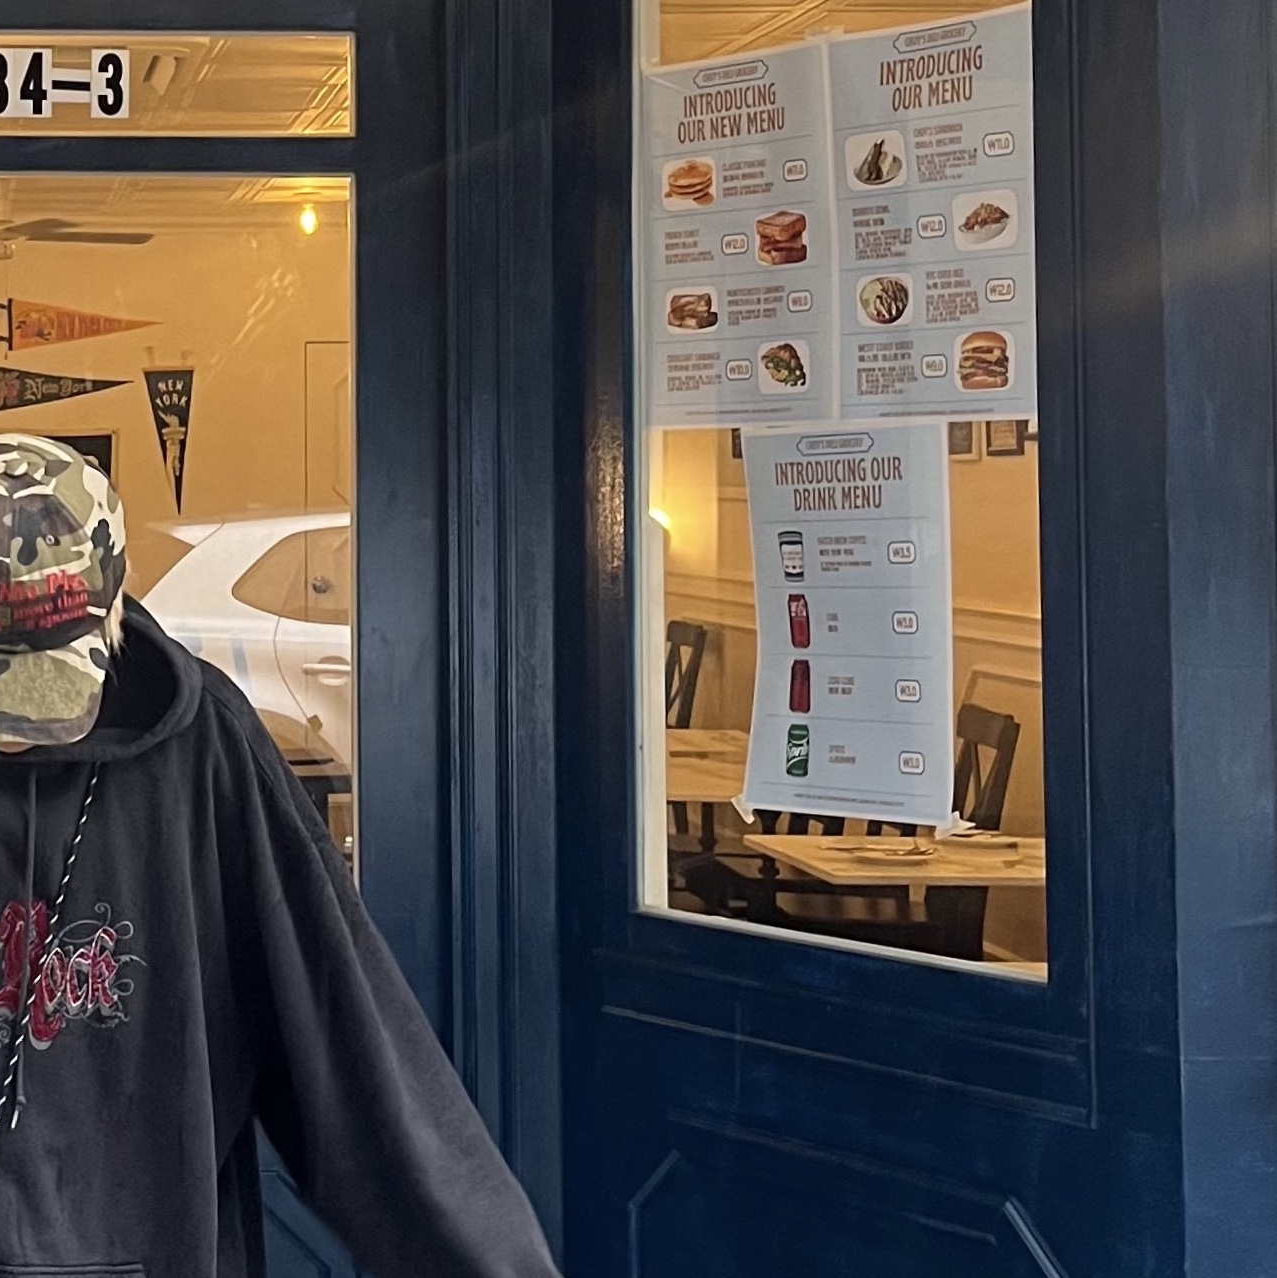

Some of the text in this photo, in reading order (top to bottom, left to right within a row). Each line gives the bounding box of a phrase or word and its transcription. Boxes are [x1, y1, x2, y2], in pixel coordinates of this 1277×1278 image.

[879, 44, 983, 86] INTRODUCING
[683, 82, 776, 118] INTRODUCING
[892, 75, 973, 112] OUR MENU
[678, 107, 785, 144] OUR NEW MENU
[155, 393, 188, 408] YORK
[157, 379, 184, 393] NEW
[774, 456, 903, 486] INTRODUCING OUR
[794, 484, 882, 512] DRINK MENU
